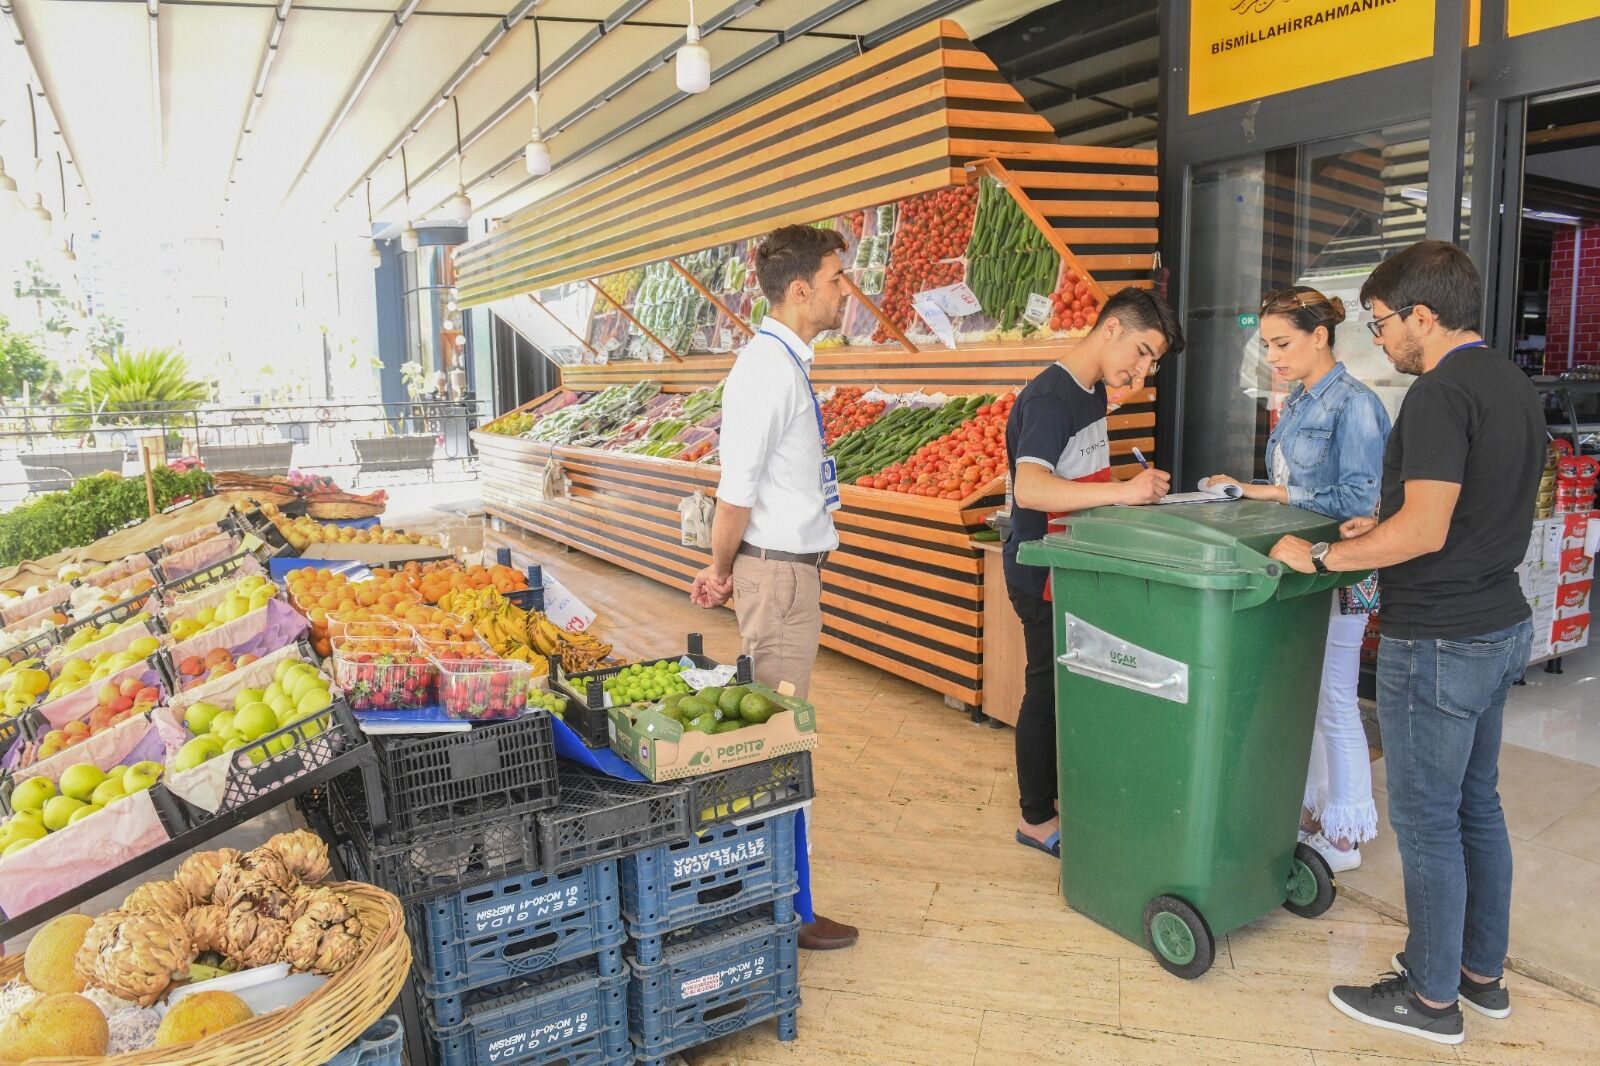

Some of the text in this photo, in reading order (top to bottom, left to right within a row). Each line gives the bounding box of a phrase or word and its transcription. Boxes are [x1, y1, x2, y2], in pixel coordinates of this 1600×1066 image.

[1241, 317, 1255, 326] OK
[673, 846, 731, 867] ADANA
[673, 843, 765, 878] ZEYNEL ACAR
[519, 890, 561, 912] NO:40-41
[476, 911, 530, 932] GIDA
[720, 961, 751, 979] NO:40-4
[530, 1018, 571, 1039] NO:40-41
[489, 1040, 540, 1061] GIDA
